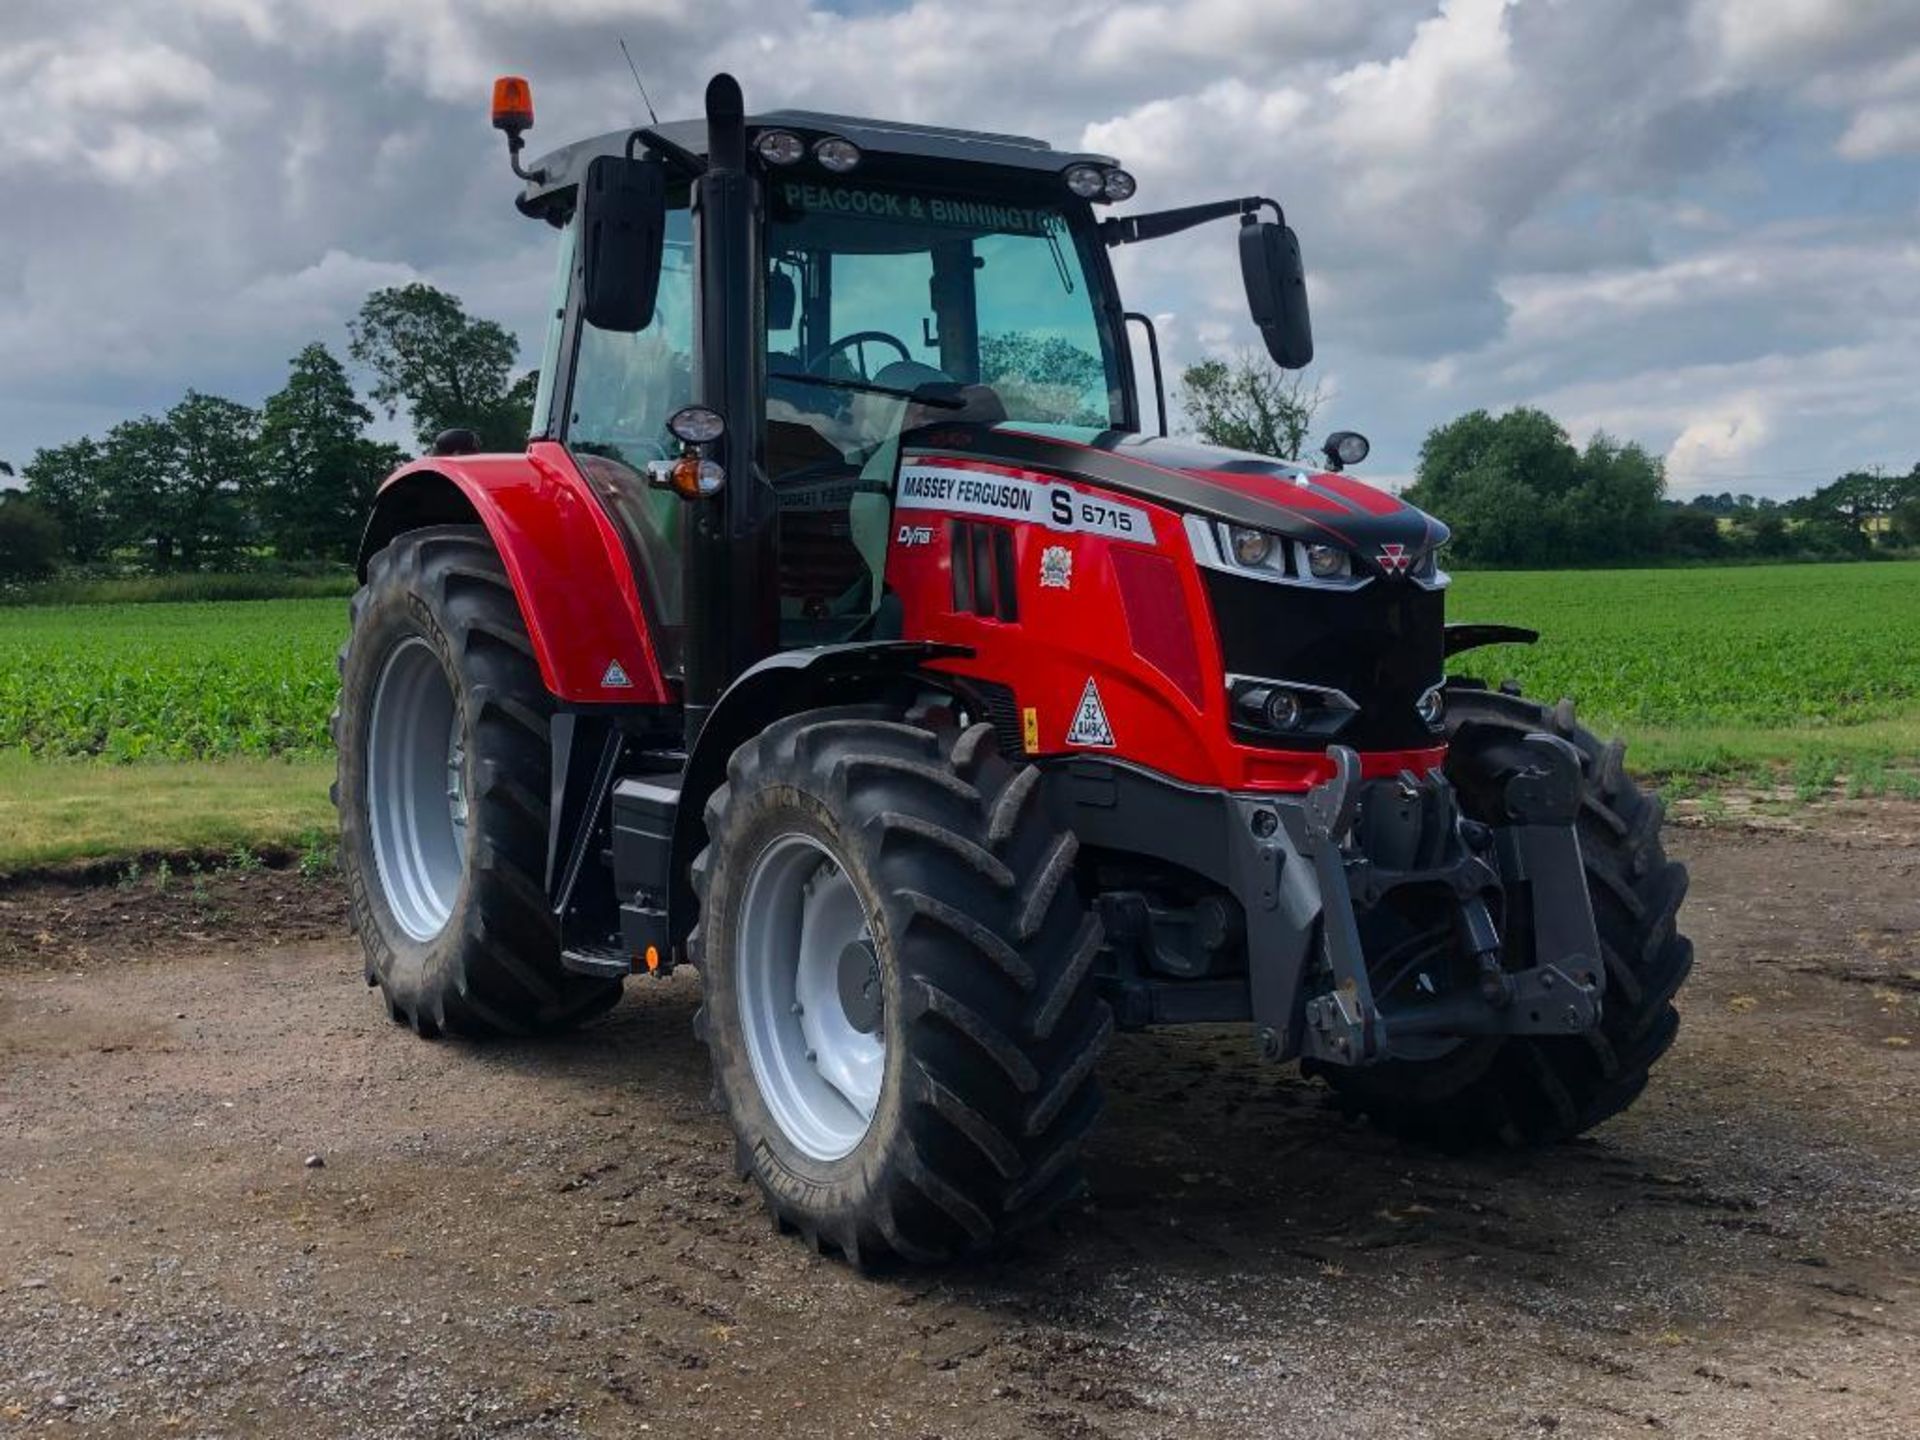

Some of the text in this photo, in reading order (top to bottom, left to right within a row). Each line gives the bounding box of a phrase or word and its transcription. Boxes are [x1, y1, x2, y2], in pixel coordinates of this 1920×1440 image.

[785, 183, 1067, 233] PEACOCK & BINNINGTON
[904, 476, 956, 498] MASSEY
[957, 481, 1033, 512] FERGUSON
[1051, 489, 1073, 526] S
[1082, 505, 1133, 532] 6715
[1084, 704, 1097, 720] 32
